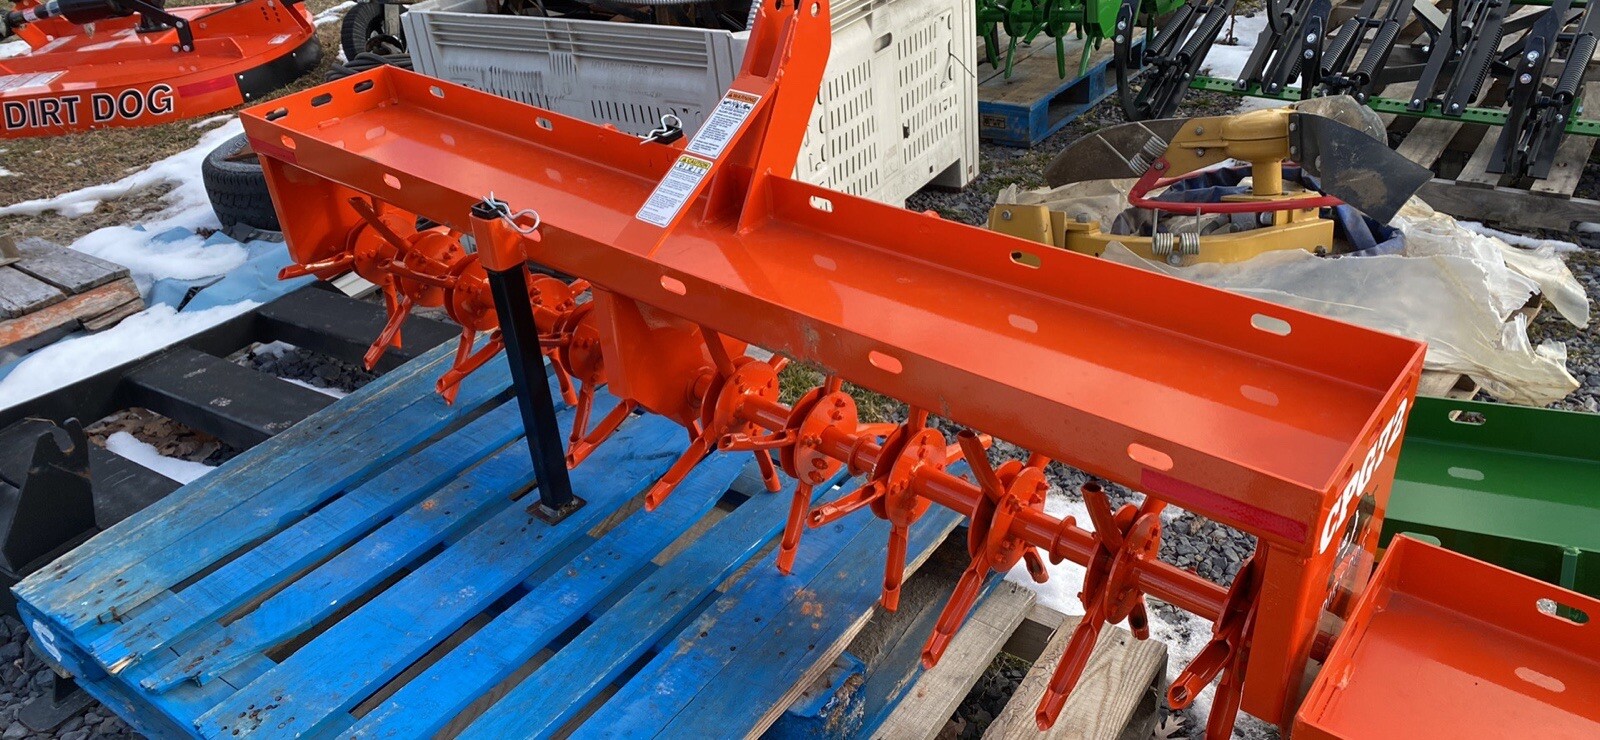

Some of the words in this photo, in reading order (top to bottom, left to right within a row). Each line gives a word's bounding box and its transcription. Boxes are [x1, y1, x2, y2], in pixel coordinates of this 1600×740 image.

[4, 95, 81, 130] DIRT
[91, 83, 174, 122] DOG
[1320, 397, 1408, 555] CPG72
